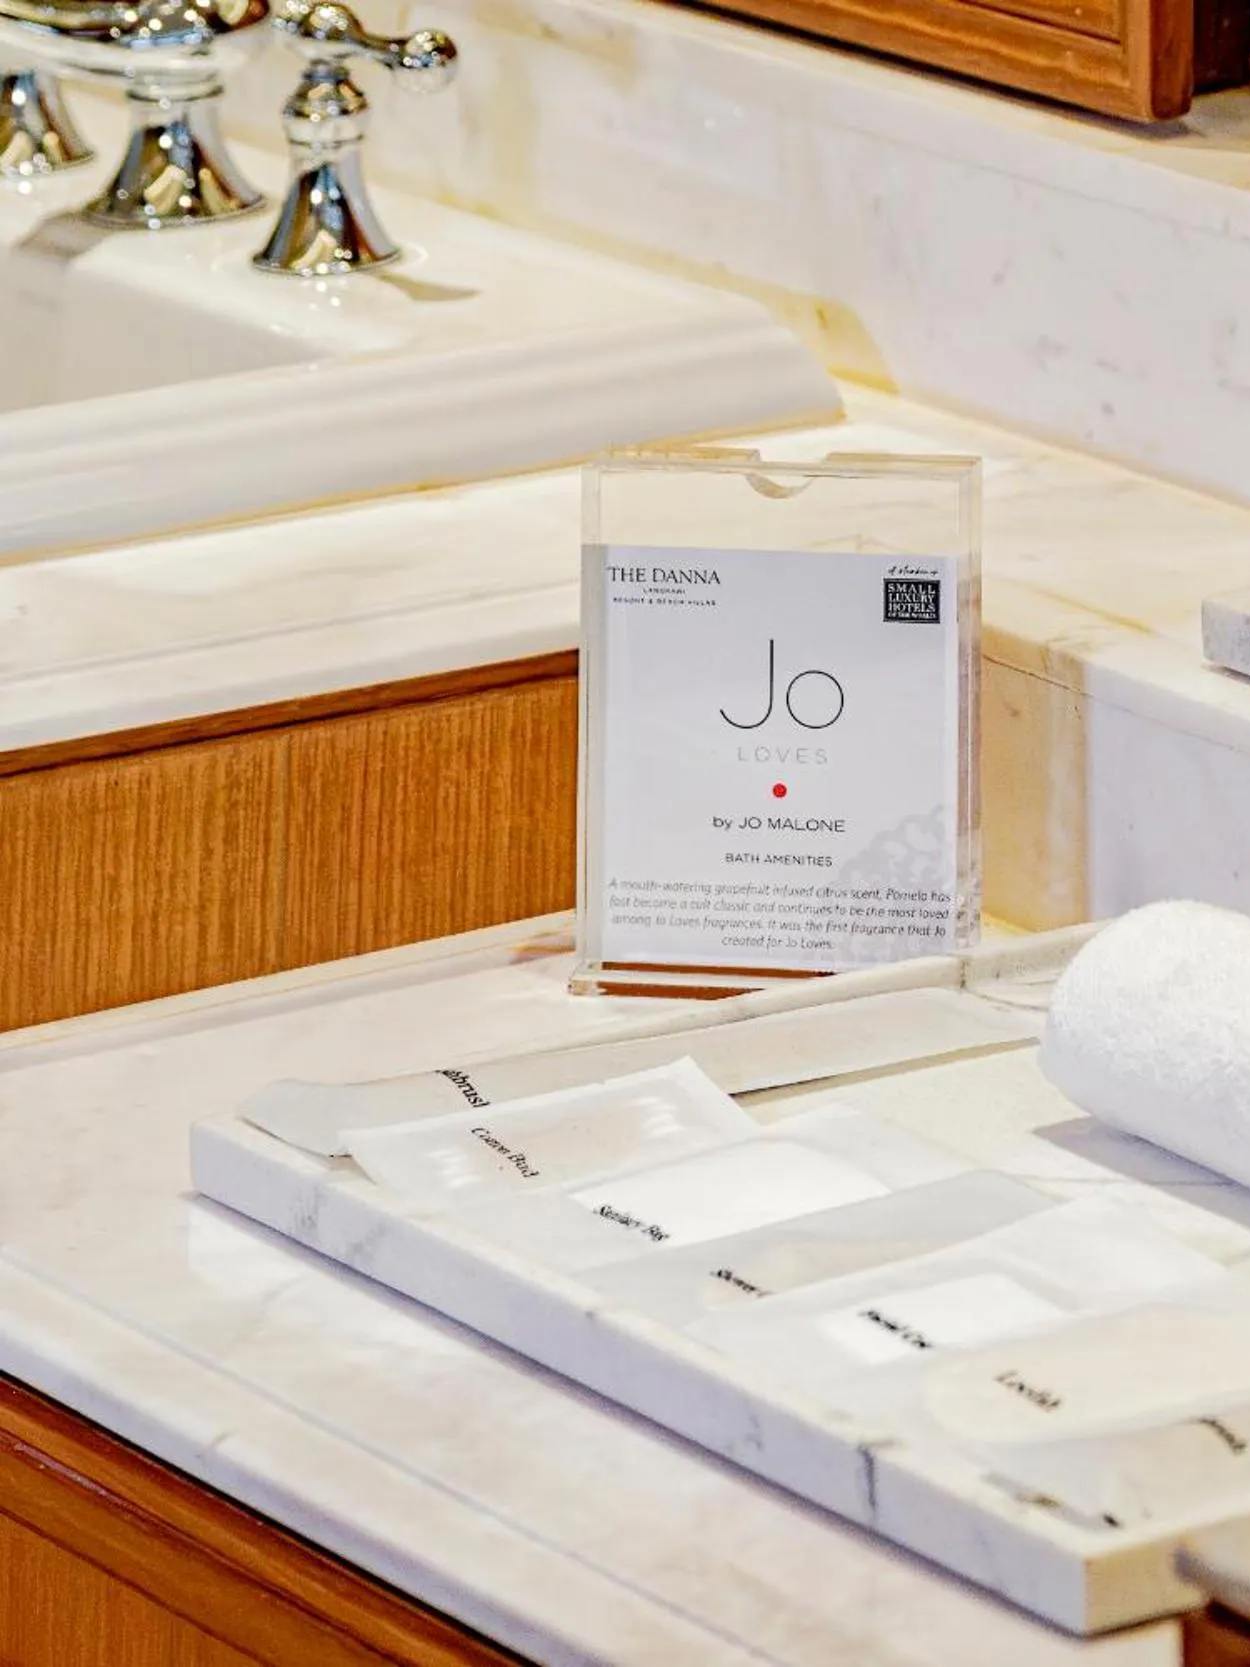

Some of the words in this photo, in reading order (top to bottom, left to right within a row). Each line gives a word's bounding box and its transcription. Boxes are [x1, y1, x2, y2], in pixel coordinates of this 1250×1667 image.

[607, 567, 647, 583] THE
[652, 567, 721, 585] DANNA
[887, 583, 936, 594] SMALL
[887, 593, 936, 603] LUXURY
[887, 602, 936, 613] HOTELS
[719, 638, 844, 729] Jo
[737, 746, 829, 765] LOVES
[712, 815, 732, 830] by
[738, 816, 762, 830] JO
[767, 817, 846, 833] MALONE
[725, 852, 760, 864] BATH
[763, 854, 833, 868] AMENITIES
[608, 878, 619, 888] A
[621, 880, 712, 896] mouth-watering
[714, 882, 770, 898] grapefruit
[772, 885, 814, 898] infused
[815, 888, 848, 899] citrus
[930, 892, 951, 902] has
[632, 896, 677, 909] become
[713, 900, 750, 913] classic
[752, 900, 775, 913] and
[777, 902, 833, 916] continues
[835, 904, 847, 915] to
[849, 905, 865, 917] be
[866, 905, 886, 918] the
[888, 908, 917, 919] most
[919, 908, 950, 921] loved
[612, 915, 652, 927] among
[669, 914, 701, 928] Loves
[779, 920, 802, 932] was
[805, 920, 824, 932] the
[825, 920, 849, 934] first
[850, 921, 905, 937] fragrance
[907, 924, 932, 936] that
[933, 925, 947, 937] Jo
[720, 935, 766, 947] created
[766, 934, 783, 950] for
[785, 938, 798, 949] Jo
